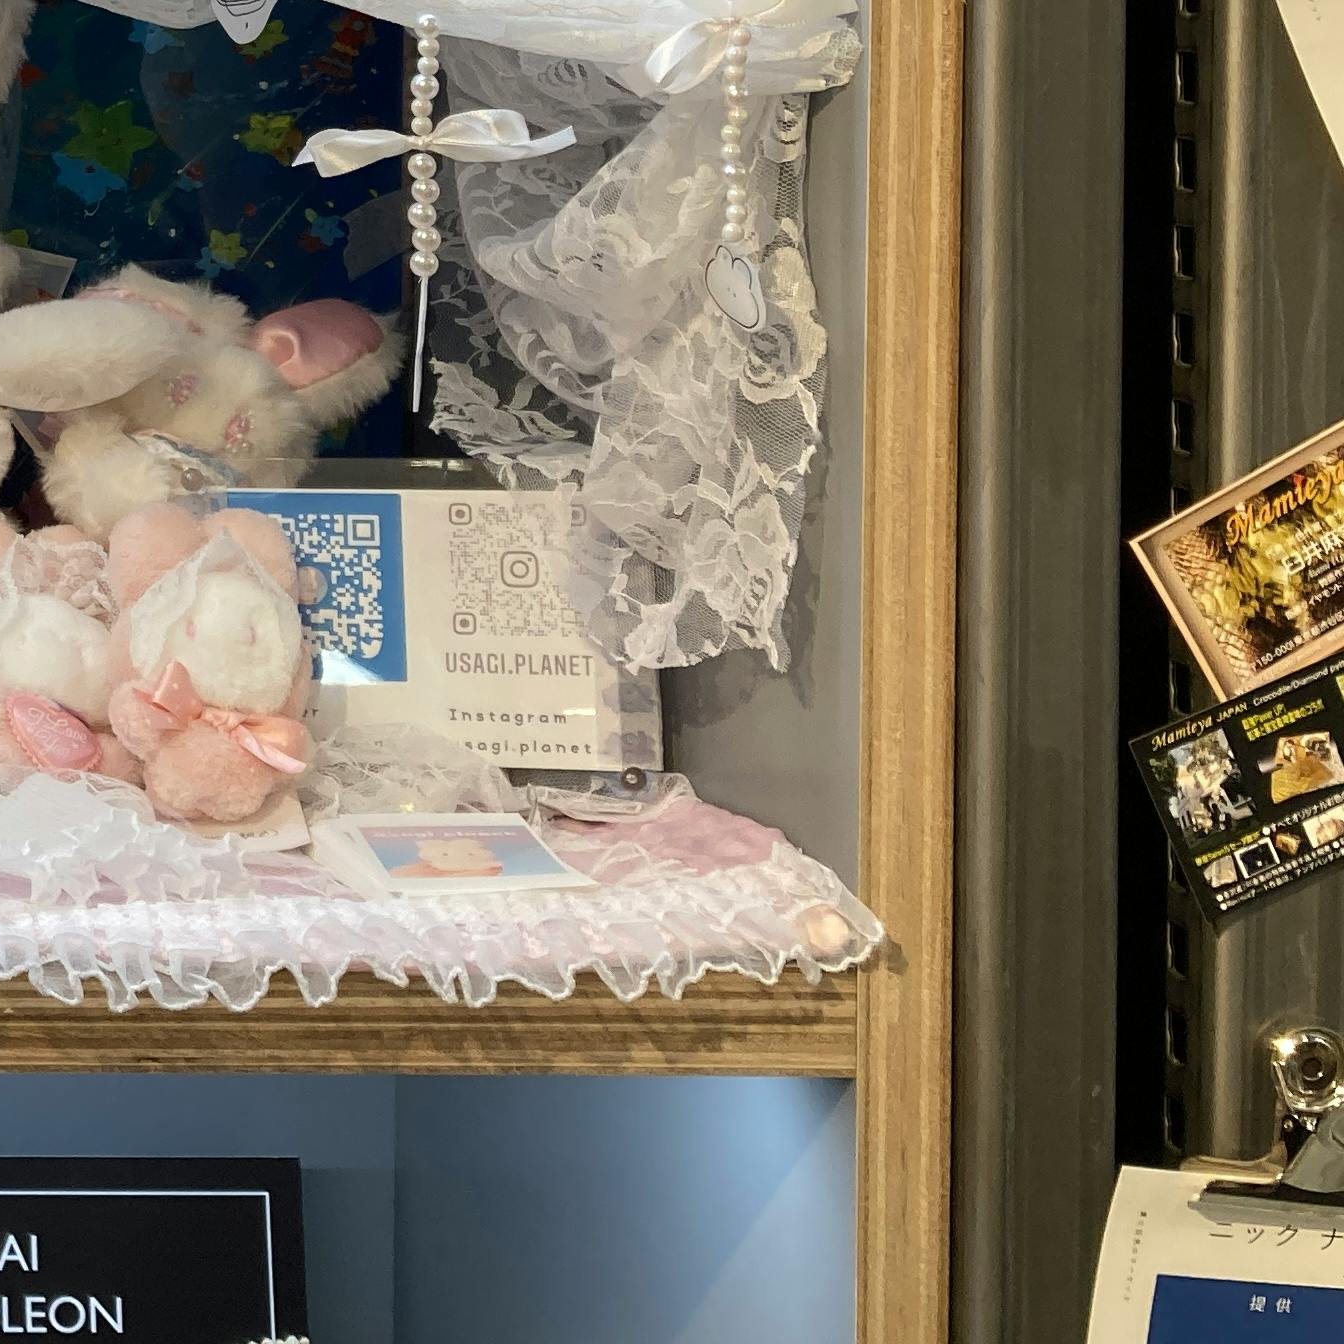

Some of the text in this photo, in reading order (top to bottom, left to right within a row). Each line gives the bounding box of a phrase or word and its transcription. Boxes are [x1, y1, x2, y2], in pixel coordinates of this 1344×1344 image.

[444, 651, 595, 678] USAGI.PLANET
[448, 707, 568, 726] Instagram
[1151, 714, 1213, 752] Mamieya
[461, 738, 593, 757] sagi.planet
